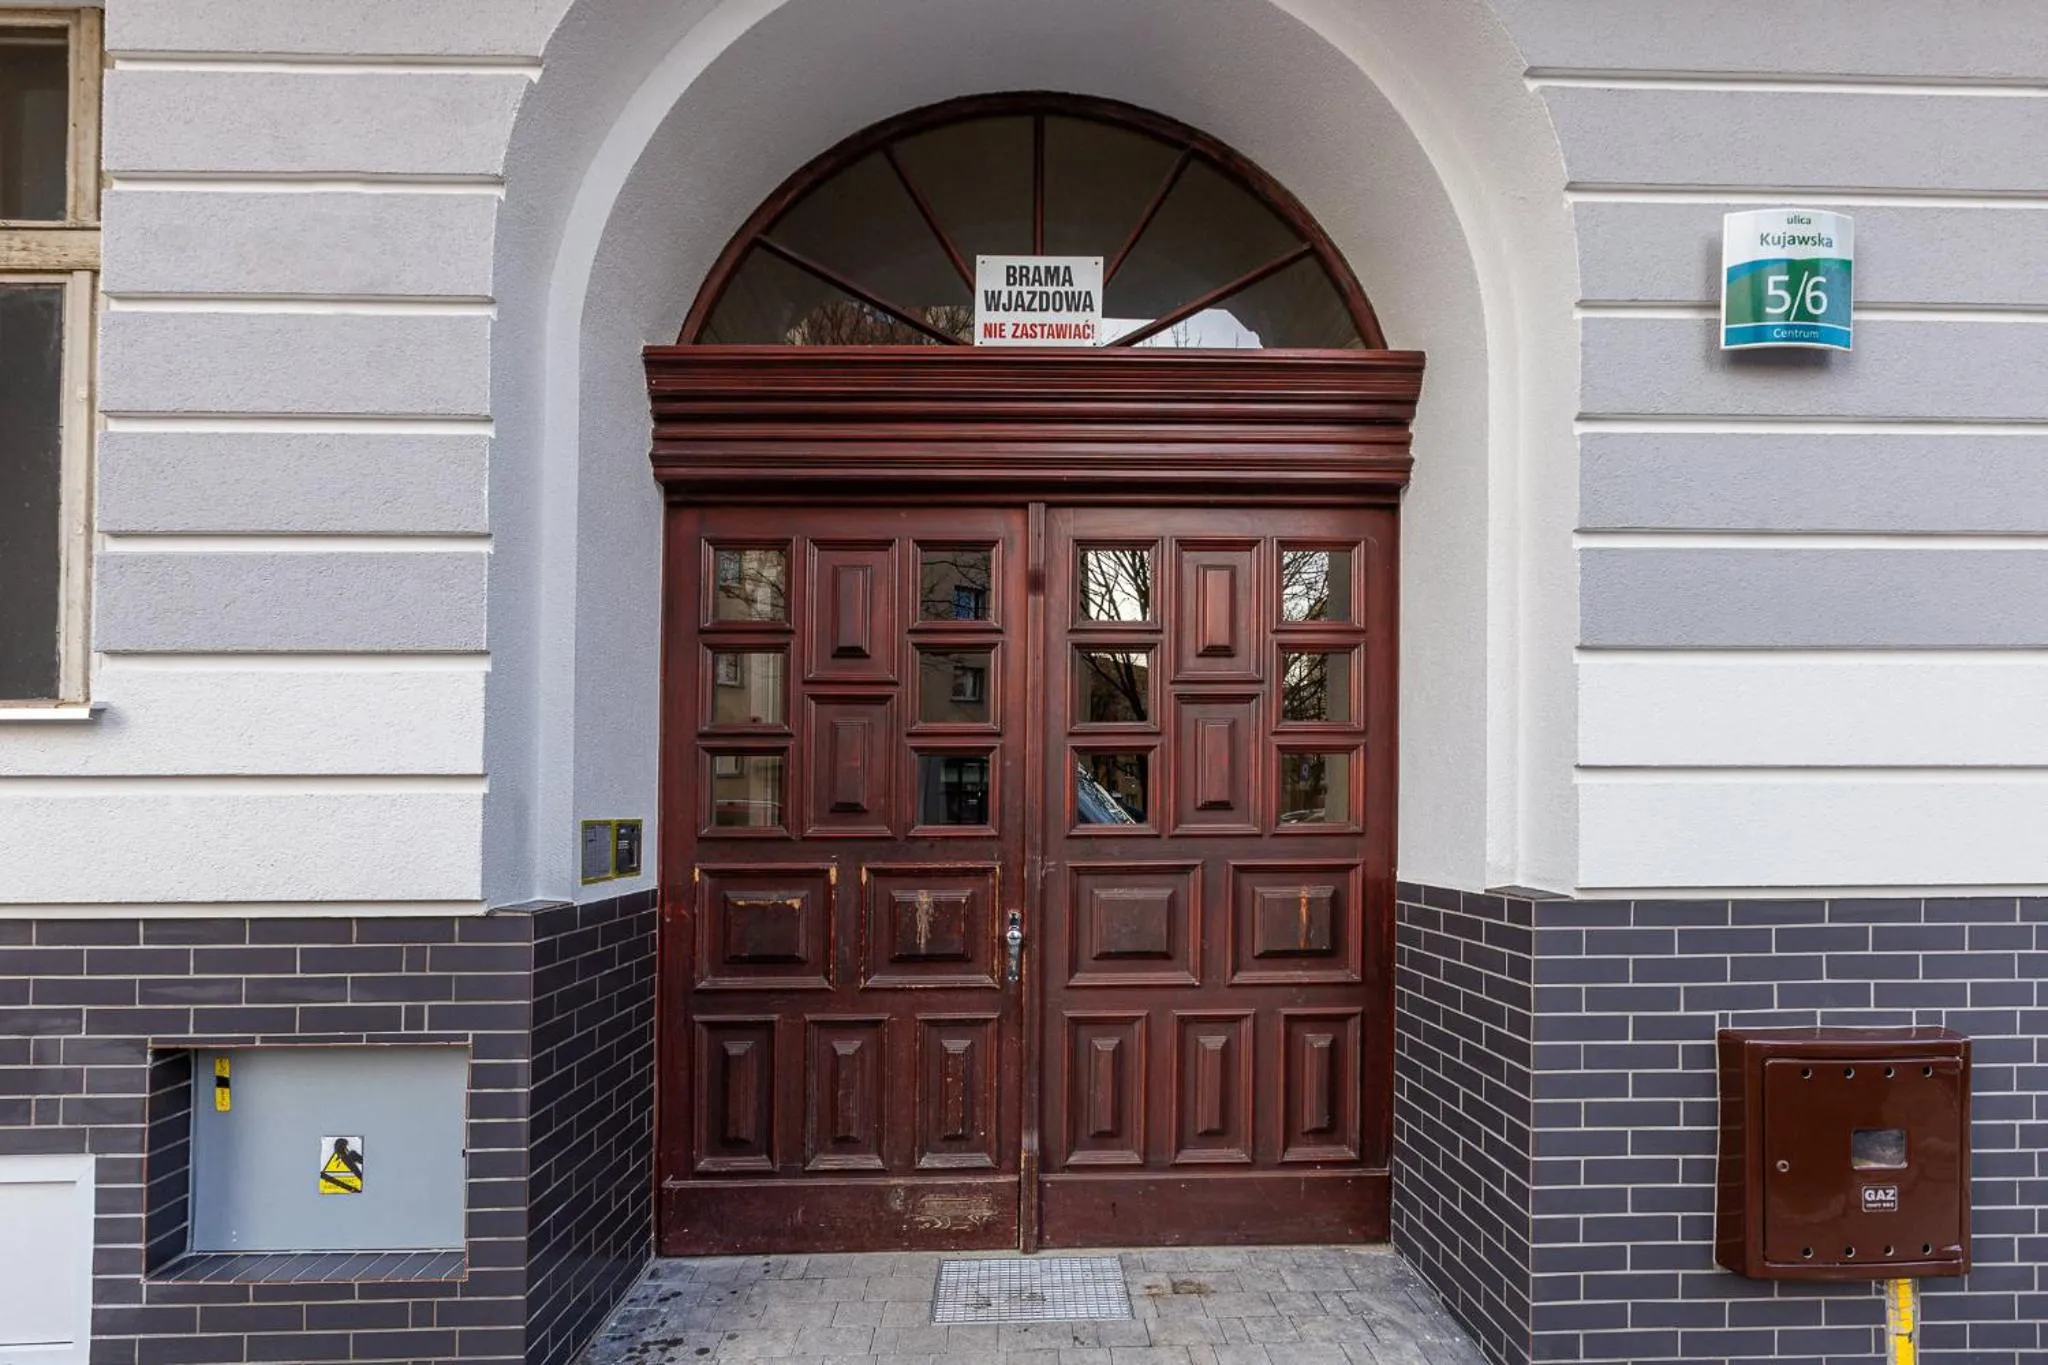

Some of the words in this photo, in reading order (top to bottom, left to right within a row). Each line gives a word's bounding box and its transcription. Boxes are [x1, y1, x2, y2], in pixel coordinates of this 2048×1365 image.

[1786, 214, 1811, 225] ulica
[1759, 232, 1833, 248] Kujawska
[1005, 265, 1074, 287] BRAMA
[983, 289, 1095, 313] WJAZDOWA
[1765, 271, 1828, 321] 5/6
[983, 322, 1006, 339] NIE
[1011, 319, 1095, 340] ZASTAWIAĆ!
[1773, 328, 1819, 339] Centrum
[1864, 1189, 1895, 1201] GAZ
